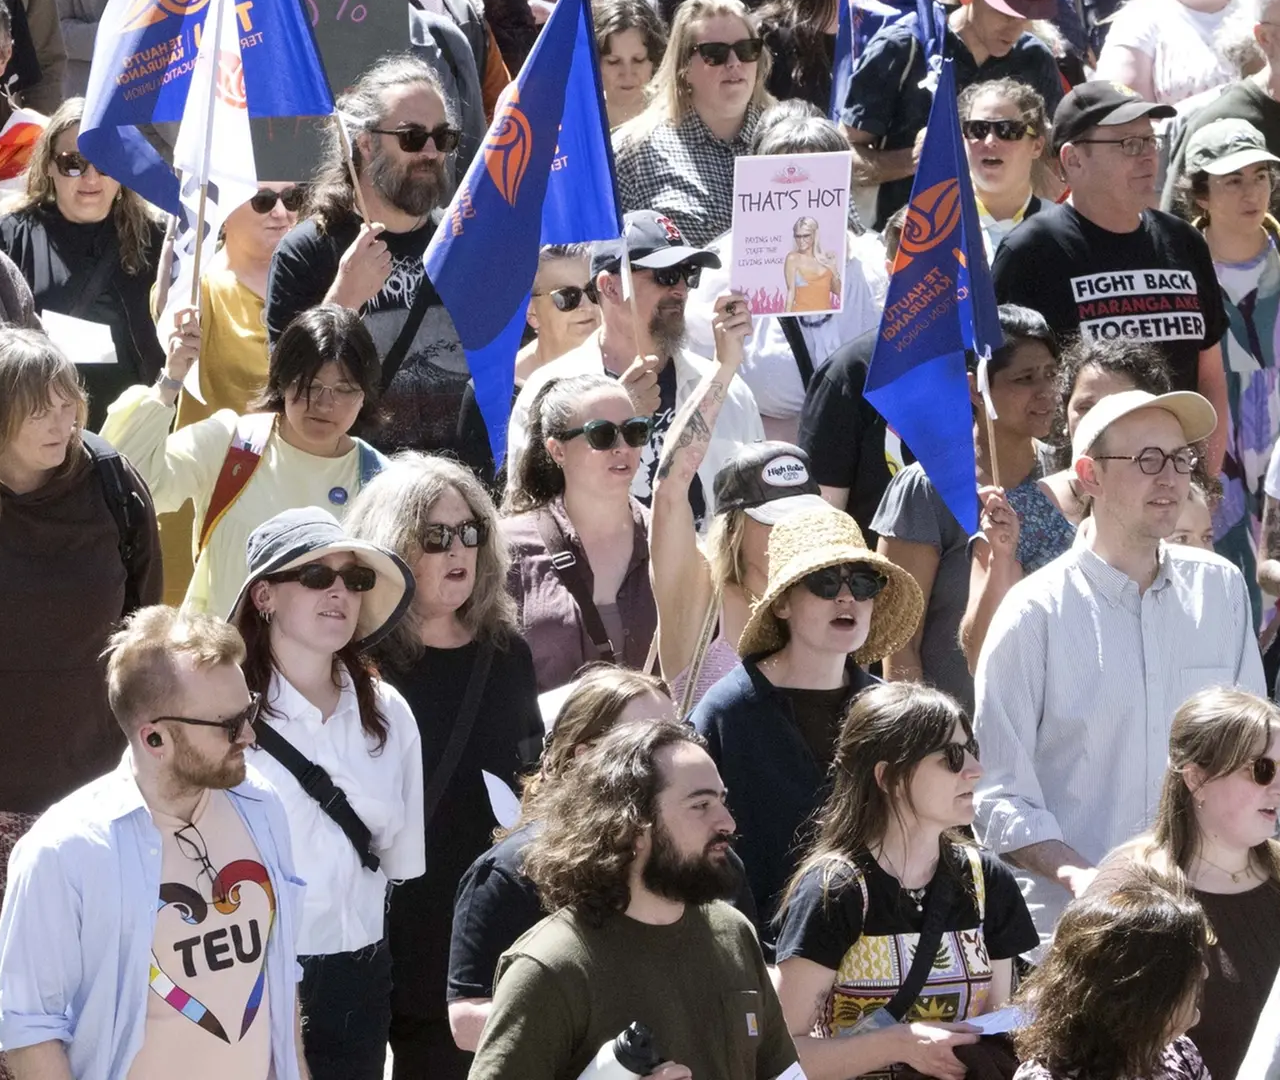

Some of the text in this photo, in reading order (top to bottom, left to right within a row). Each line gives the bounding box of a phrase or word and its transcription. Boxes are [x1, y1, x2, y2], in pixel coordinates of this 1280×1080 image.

[738, 187, 846, 214] THAT'S HOT
[1074, 273, 1193, 298] FIGHT BACK
[1077, 295, 1201, 320] MARANGA AKE
[1087, 316, 1204, 342] TOGETHER
[173, 918, 263, 978] TEU
